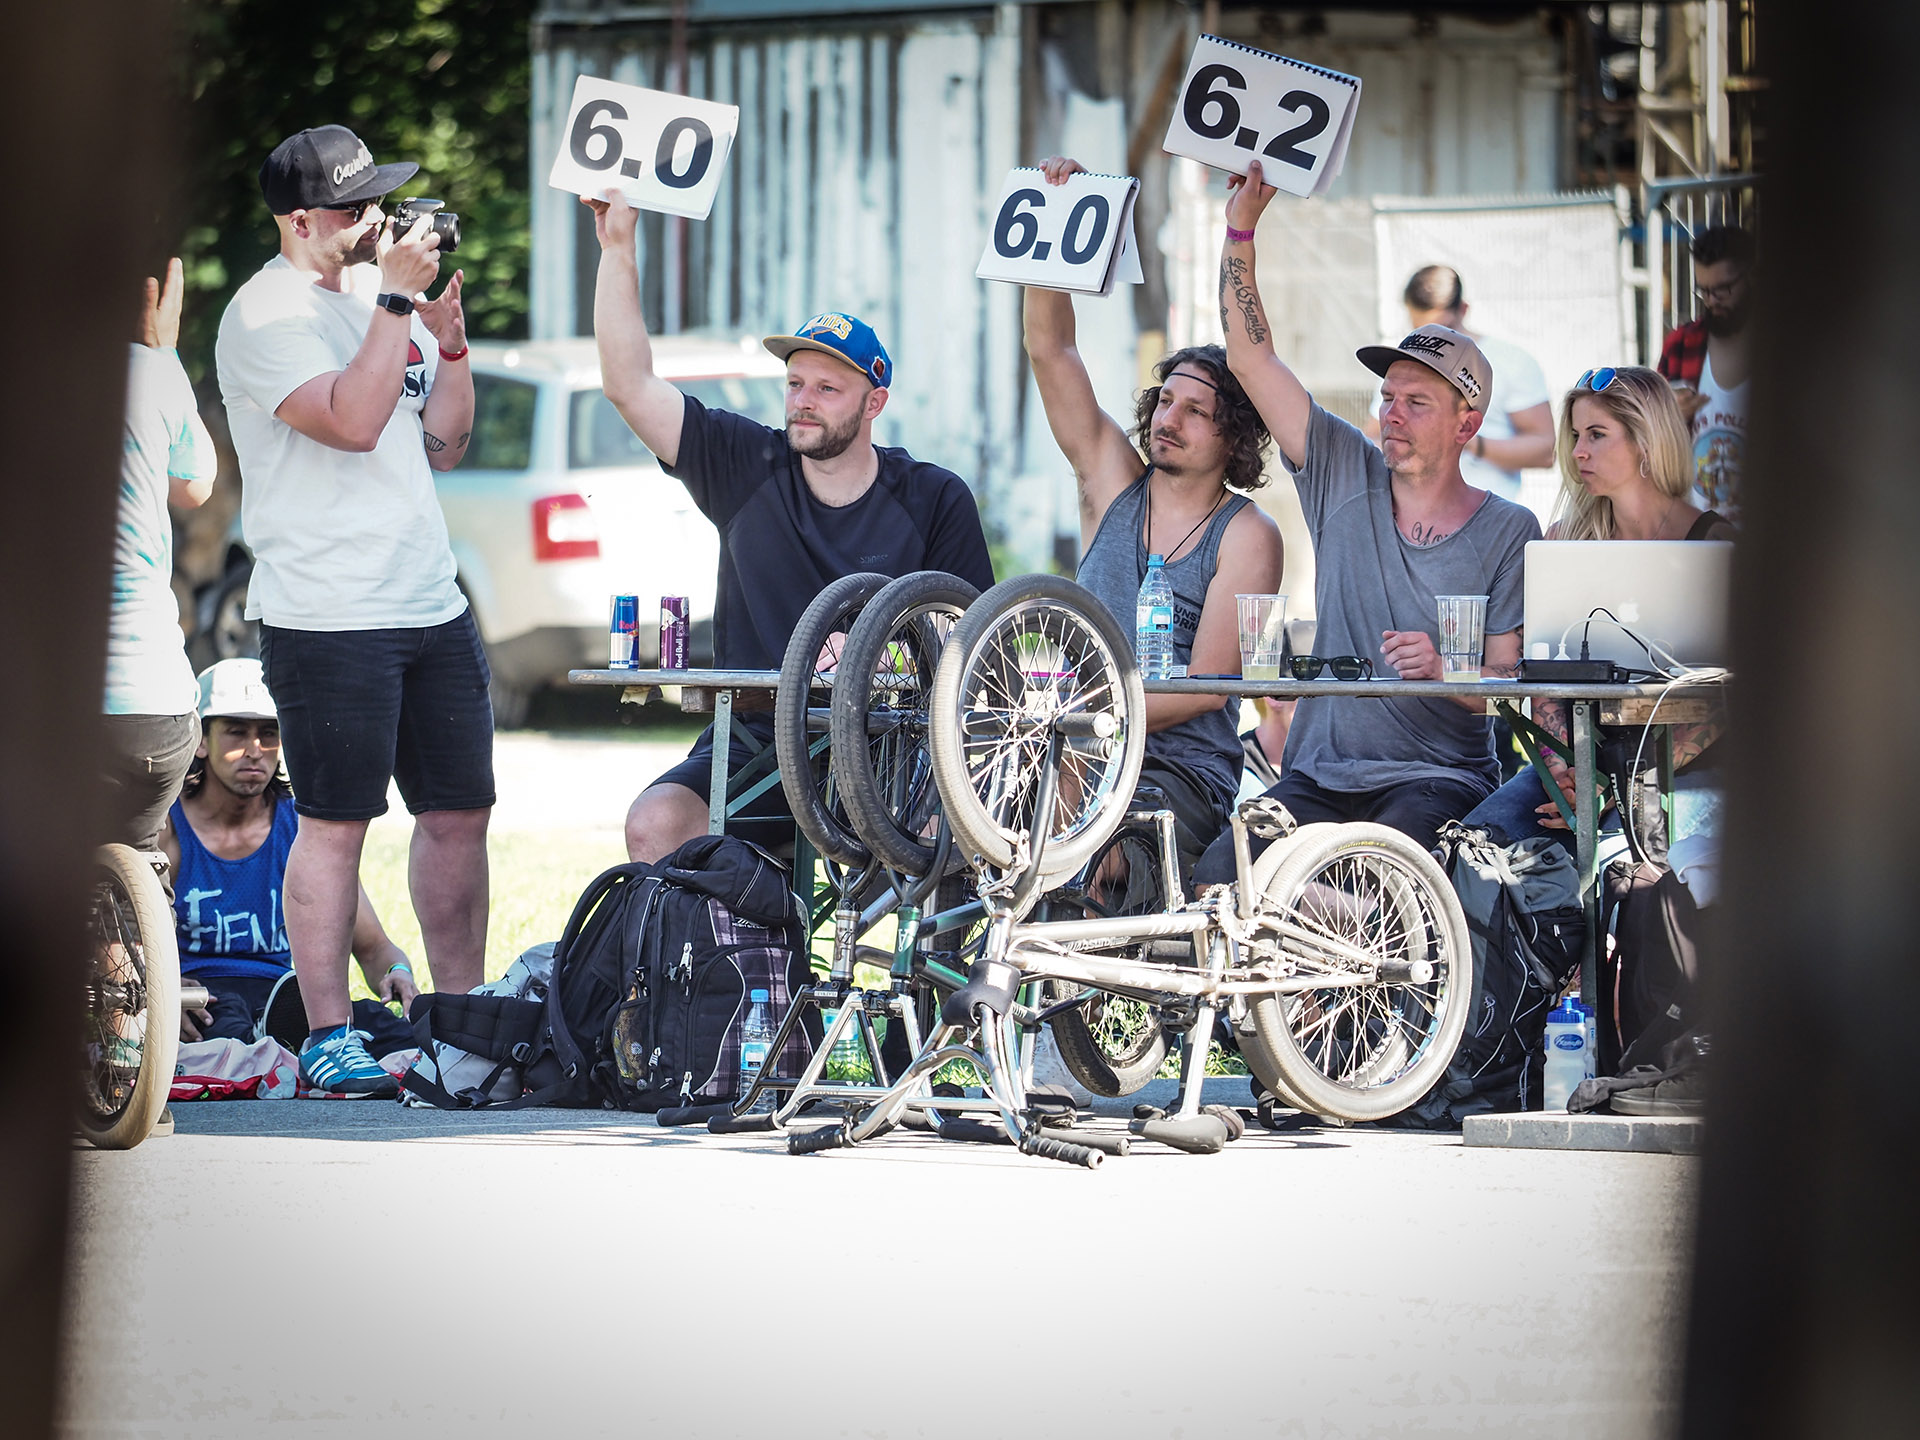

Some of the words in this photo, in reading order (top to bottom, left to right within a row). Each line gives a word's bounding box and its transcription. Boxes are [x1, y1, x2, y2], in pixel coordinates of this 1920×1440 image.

[570, 99, 714, 189] 6.0
[1184, 64, 1330, 170] 6.2
[994, 188, 1110, 265] 6.0
